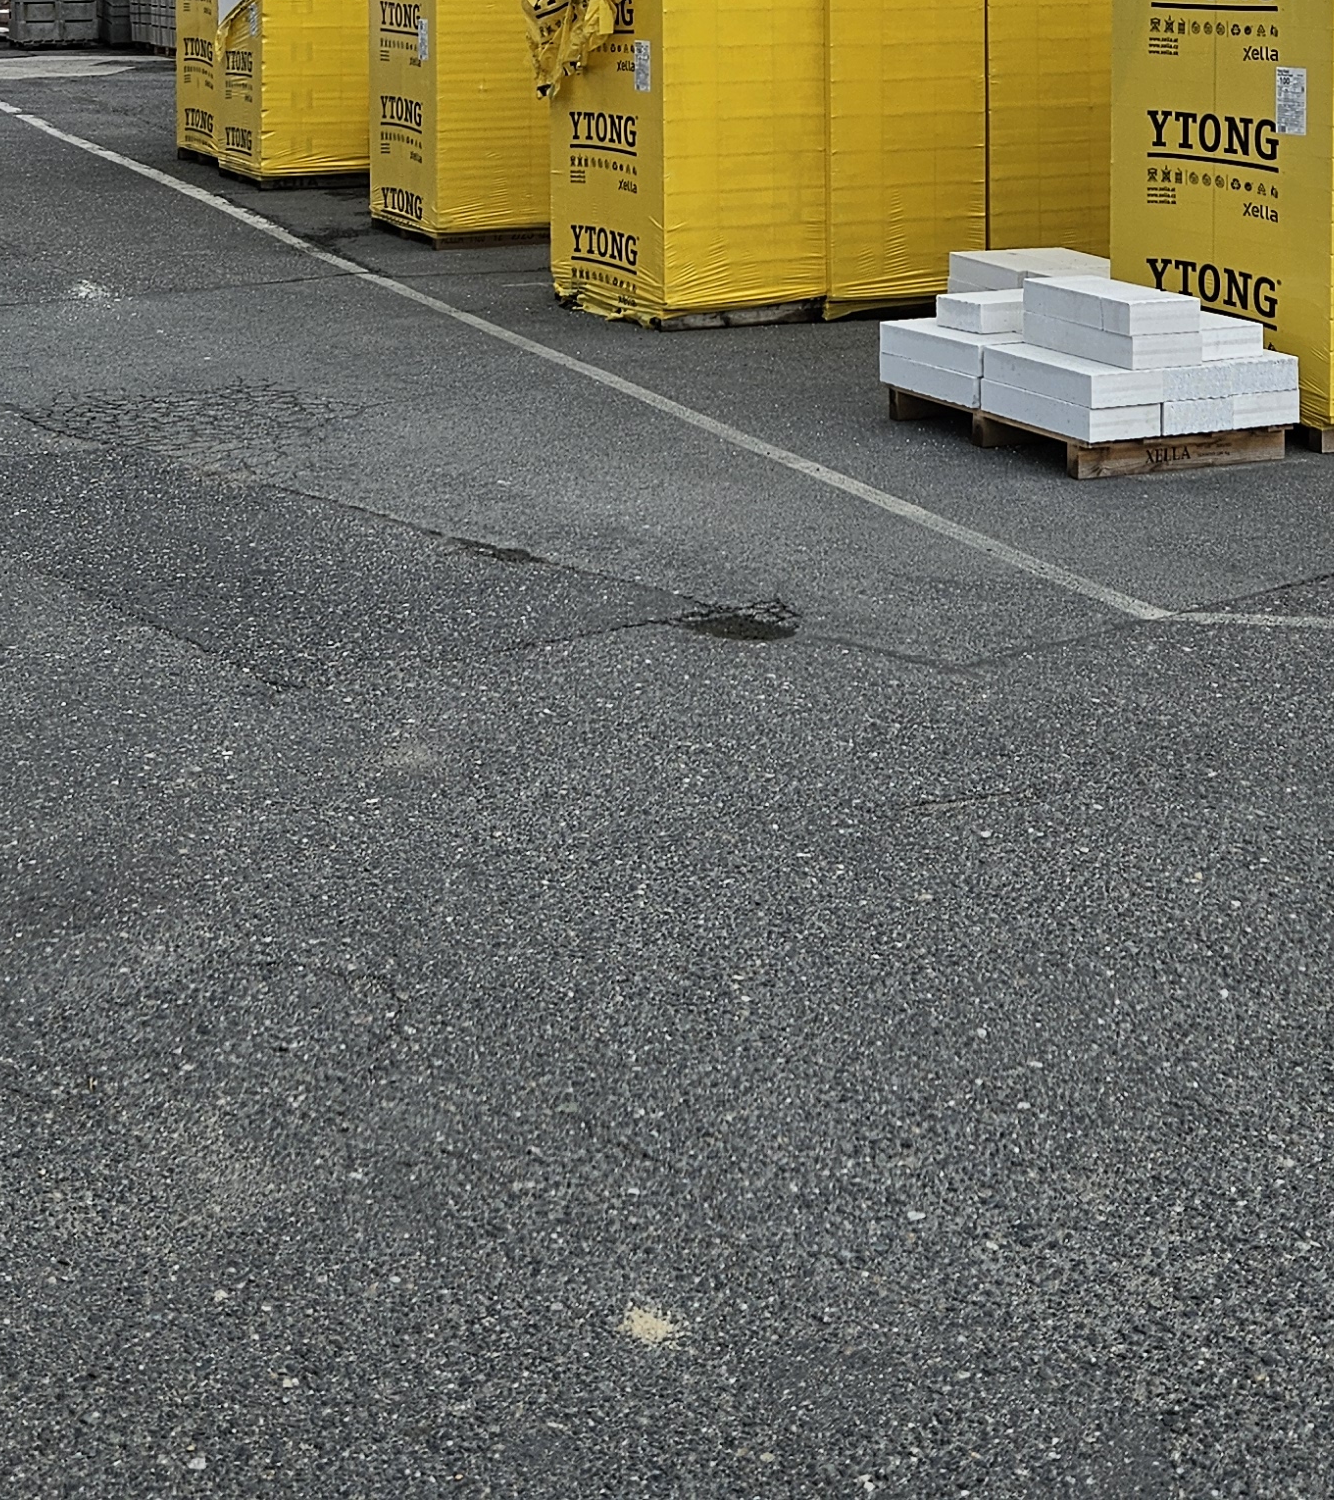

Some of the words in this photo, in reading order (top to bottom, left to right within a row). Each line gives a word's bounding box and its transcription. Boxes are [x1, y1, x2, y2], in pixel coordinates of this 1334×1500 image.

[380, 0, 421, 30] YTONG
[183, 37, 213, 62] YTONG
[225, 50, 253, 73] YTONG
[1243, 46, 1280, 61] Xella
[184, 107, 214, 133] YTONG
[380, 95, 422, 127] YTONG
[225, 126, 252, 151] YTONG
[569, 111, 637, 148] YTONG
[1147, 109, 1280, 161] YTONG
[381, 186, 423, 221] YTONG
[1242, 202, 1279, 224] Xella
[571, 225, 638, 267] YTONG
[1146, 258, 1279, 320] YTONG
[1145, 446, 1192, 464] XELLA
